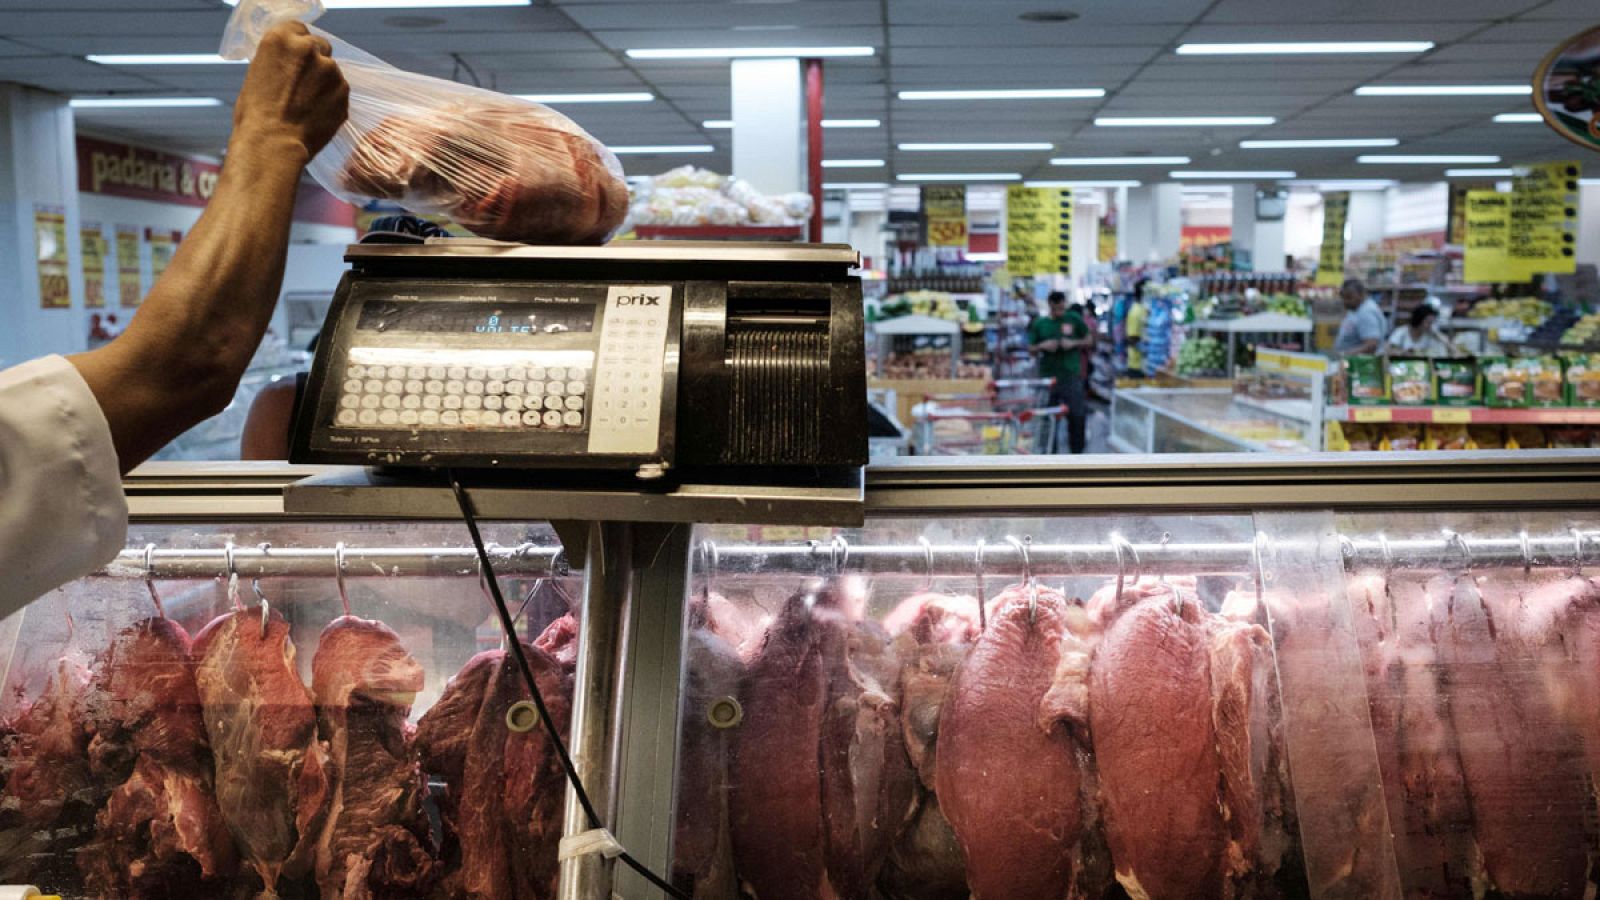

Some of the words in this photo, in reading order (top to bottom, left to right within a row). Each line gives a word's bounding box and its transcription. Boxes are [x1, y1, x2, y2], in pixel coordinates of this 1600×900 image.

[92, 147, 176, 192] padaria
[181, 162, 193, 194] &
[616, 294, 660, 308] prix
